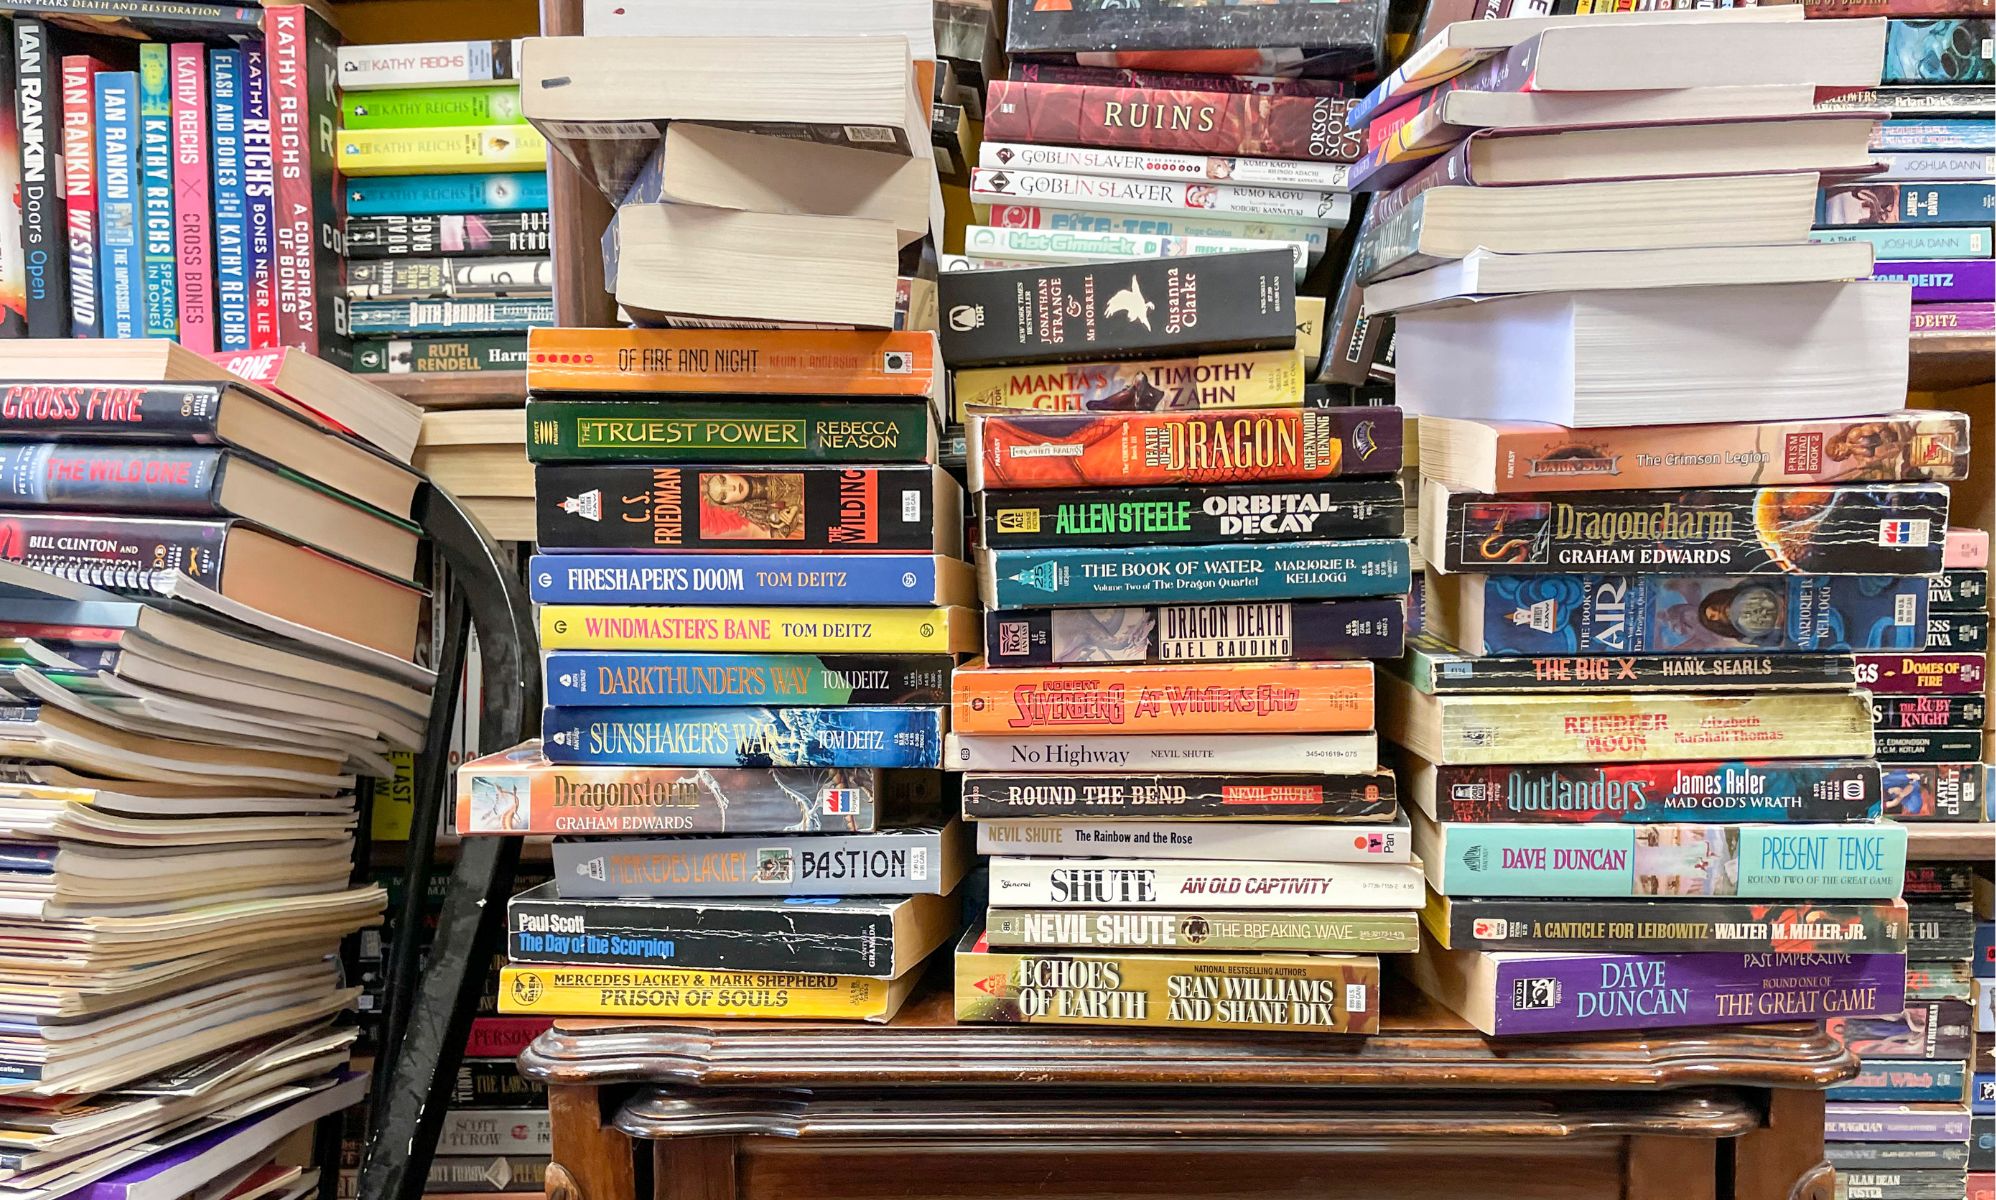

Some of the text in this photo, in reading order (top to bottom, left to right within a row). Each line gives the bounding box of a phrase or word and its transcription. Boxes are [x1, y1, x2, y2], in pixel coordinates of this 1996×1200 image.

[72, 0, 108, 9] DEATH
[113, 3, 137, 11] AND
[142, 4, 221, 17] RESTORATION
[372, 58, 415, 71] KATHY
[420, 56, 464, 70] REICHS
[177, 56, 198, 164] KATHY REICHS
[1105, 103, 1214, 131] RUINS
[1308, 97, 1326, 156] ORSON
[18, 25, 45, 299] IAN RANKIN Doors Open
[1905, 160, 1980, 170] JOSHUA DANN
[64, 67, 95, 326] IAN RANKIN WESTWIND
[1021, 176, 1172, 202] GOBLIN SLAYER
[1233, 188, 1303, 201] KUMO KAGYU
[183, 214, 203, 324] CROSS BONES
[1166, 267, 1179, 333] Susanna
[1182, 272, 1196, 327] Clarke
[976, 304, 985, 327] TOR
[1039, 278, 1047, 344] JONATHAN
[1915, 314, 1957, 327] DEITZ
[428, 344, 469, 356] RUTH
[418, 357, 481, 370] RENDELL
[619, 349, 759, 373] OF FIRE AND NIGHT
[1150, 362, 1254, 387] TIMOTHY
[2, 386, 147, 422] CROSS FIRE
[1170, 387, 1235, 407] ZAHN
[592, 422, 799, 443] TRUEST POWER
[815, 421, 900, 436] REBECCA
[820, 434, 897, 449] NEASON
[1638, 450, 1769, 467] The Crimson Legion
[1789, 436, 1797, 472] PRISM
[1798, 436, 1807, 471] PENTAD
[1811, 446, 1819, 472] BOOK
[47, 458, 193, 485] THE WILD ONE
[1203, 494, 1336, 513] ORBITAL
[1056, 502, 1190, 533] ALLEN STEELE
[1220, 514, 1321, 534] DECAY
[30, 536, 138, 554] BILL CLINTON AND
[1560, 549, 1730, 563] GRAHAM EDWARDS
[1082, 560, 1263, 576] THE BOOK OF WATER
[568, 568, 846, 590] FIRESHAPER'S DOOM TOM DEITZ
[1094, 583, 1122, 591] Volume
[1124, 582, 1139, 590] Two
[1153, 579, 1173, 589] The
[1176, 578, 1216, 589] Dragon
[1220, 577, 1258, 587] Quartet
[1168, 604, 1283, 638] DRAGON DEATH
[1595, 578, 1627, 650] AIR
[585, 618, 871, 639] WINDMASTER'S BANE TOM DEITZ
[1163, 641, 1289, 658] GAEL BAUDINO
[1534, 658, 1772, 680] THE BIG X HANK SEARLS
[1902, 659, 1959, 674] DOMES OF
[1918, 675, 1942, 687] FIRE
[1902, 713, 1949, 727] KNIGHT
[1012, 745, 1130, 766] No Highway
[1151, 750, 1214, 758] NEVIL SHUTE
[554, 775, 699, 811] Dragonstorm
[1673, 772, 1765, 795] James Axler
[1937, 778, 1948, 807] KATE
[1949, 769, 1959, 814] ELLIOTT
[1664, 795, 1801, 809] MAD GOD'S WRATH
[556, 816, 693, 830] GRAHAM EDWARDS
[1076, 830, 1192, 844] The Rainbow and the Rose
[1762, 836, 1884, 870] PRESENT TENSE
[802, 850, 905, 879] BASTION
[1180, 878, 1331, 895] AN OLD CAPTIVITY
[1748, 876, 1892, 884] ROUND TWO OF THE GREAT GAME
[519, 913, 584, 934] Paul Scott
[519, 934, 674, 957] The Day of the Scorpion
[1019, 961, 1119, 988] ECHOES
[1195, 965, 1306, 976] NATIONAL BESTSELLING AUTHORS
[1601, 961, 1665, 988] DAVE
[600, 990, 788, 1007] PRISON OF SOULS
[1577, 991, 1688, 1018] DUNCAN
[1927, 1005, 1938, 1041] FRIEDMAN
[455, 1120, 495, 1132] SCOTT
[450, 1133, 501, 1145] TUROW
[1849, 1175, 1900, 1185] ALAN DEAN
[1849, 1188, 1882, 1198] FOSTER
